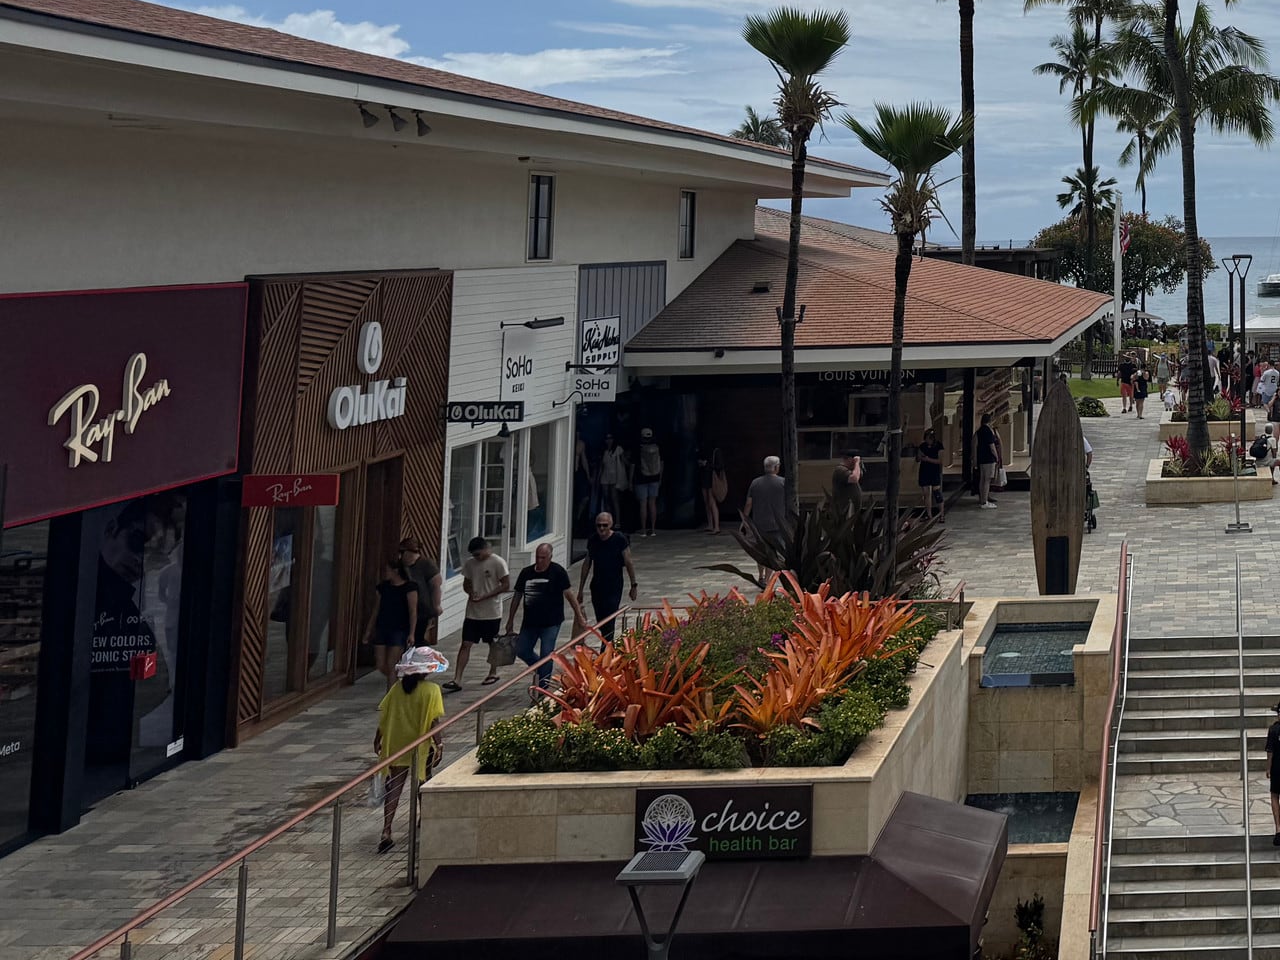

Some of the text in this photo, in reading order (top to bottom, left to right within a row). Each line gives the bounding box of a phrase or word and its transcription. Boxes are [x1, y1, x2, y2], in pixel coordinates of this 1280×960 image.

[585, 351, 617, 364] SUPPLY
[506, 355, 533, 379] SoHa
[819, 368, 915, 381] LOUIS VUITN
[1271, 375, 1276, 384] 2
[512, 382, 525, 393] KEIKI
[575, 378, 610, 390] SoHa
[48, 352, 171, 468] Ray-Ban
[327, 376, 408, 430] OluKai
[464, 404, 520, 420] OluKai
[265, 478, 312, 503] Ray-Ban
[92, 635, 152, 647] EW COLORS.
[91, 651, 119, 663] ONIC
[701, 799, 807, 832] choice
[709, 836, 798, 852] health bar
